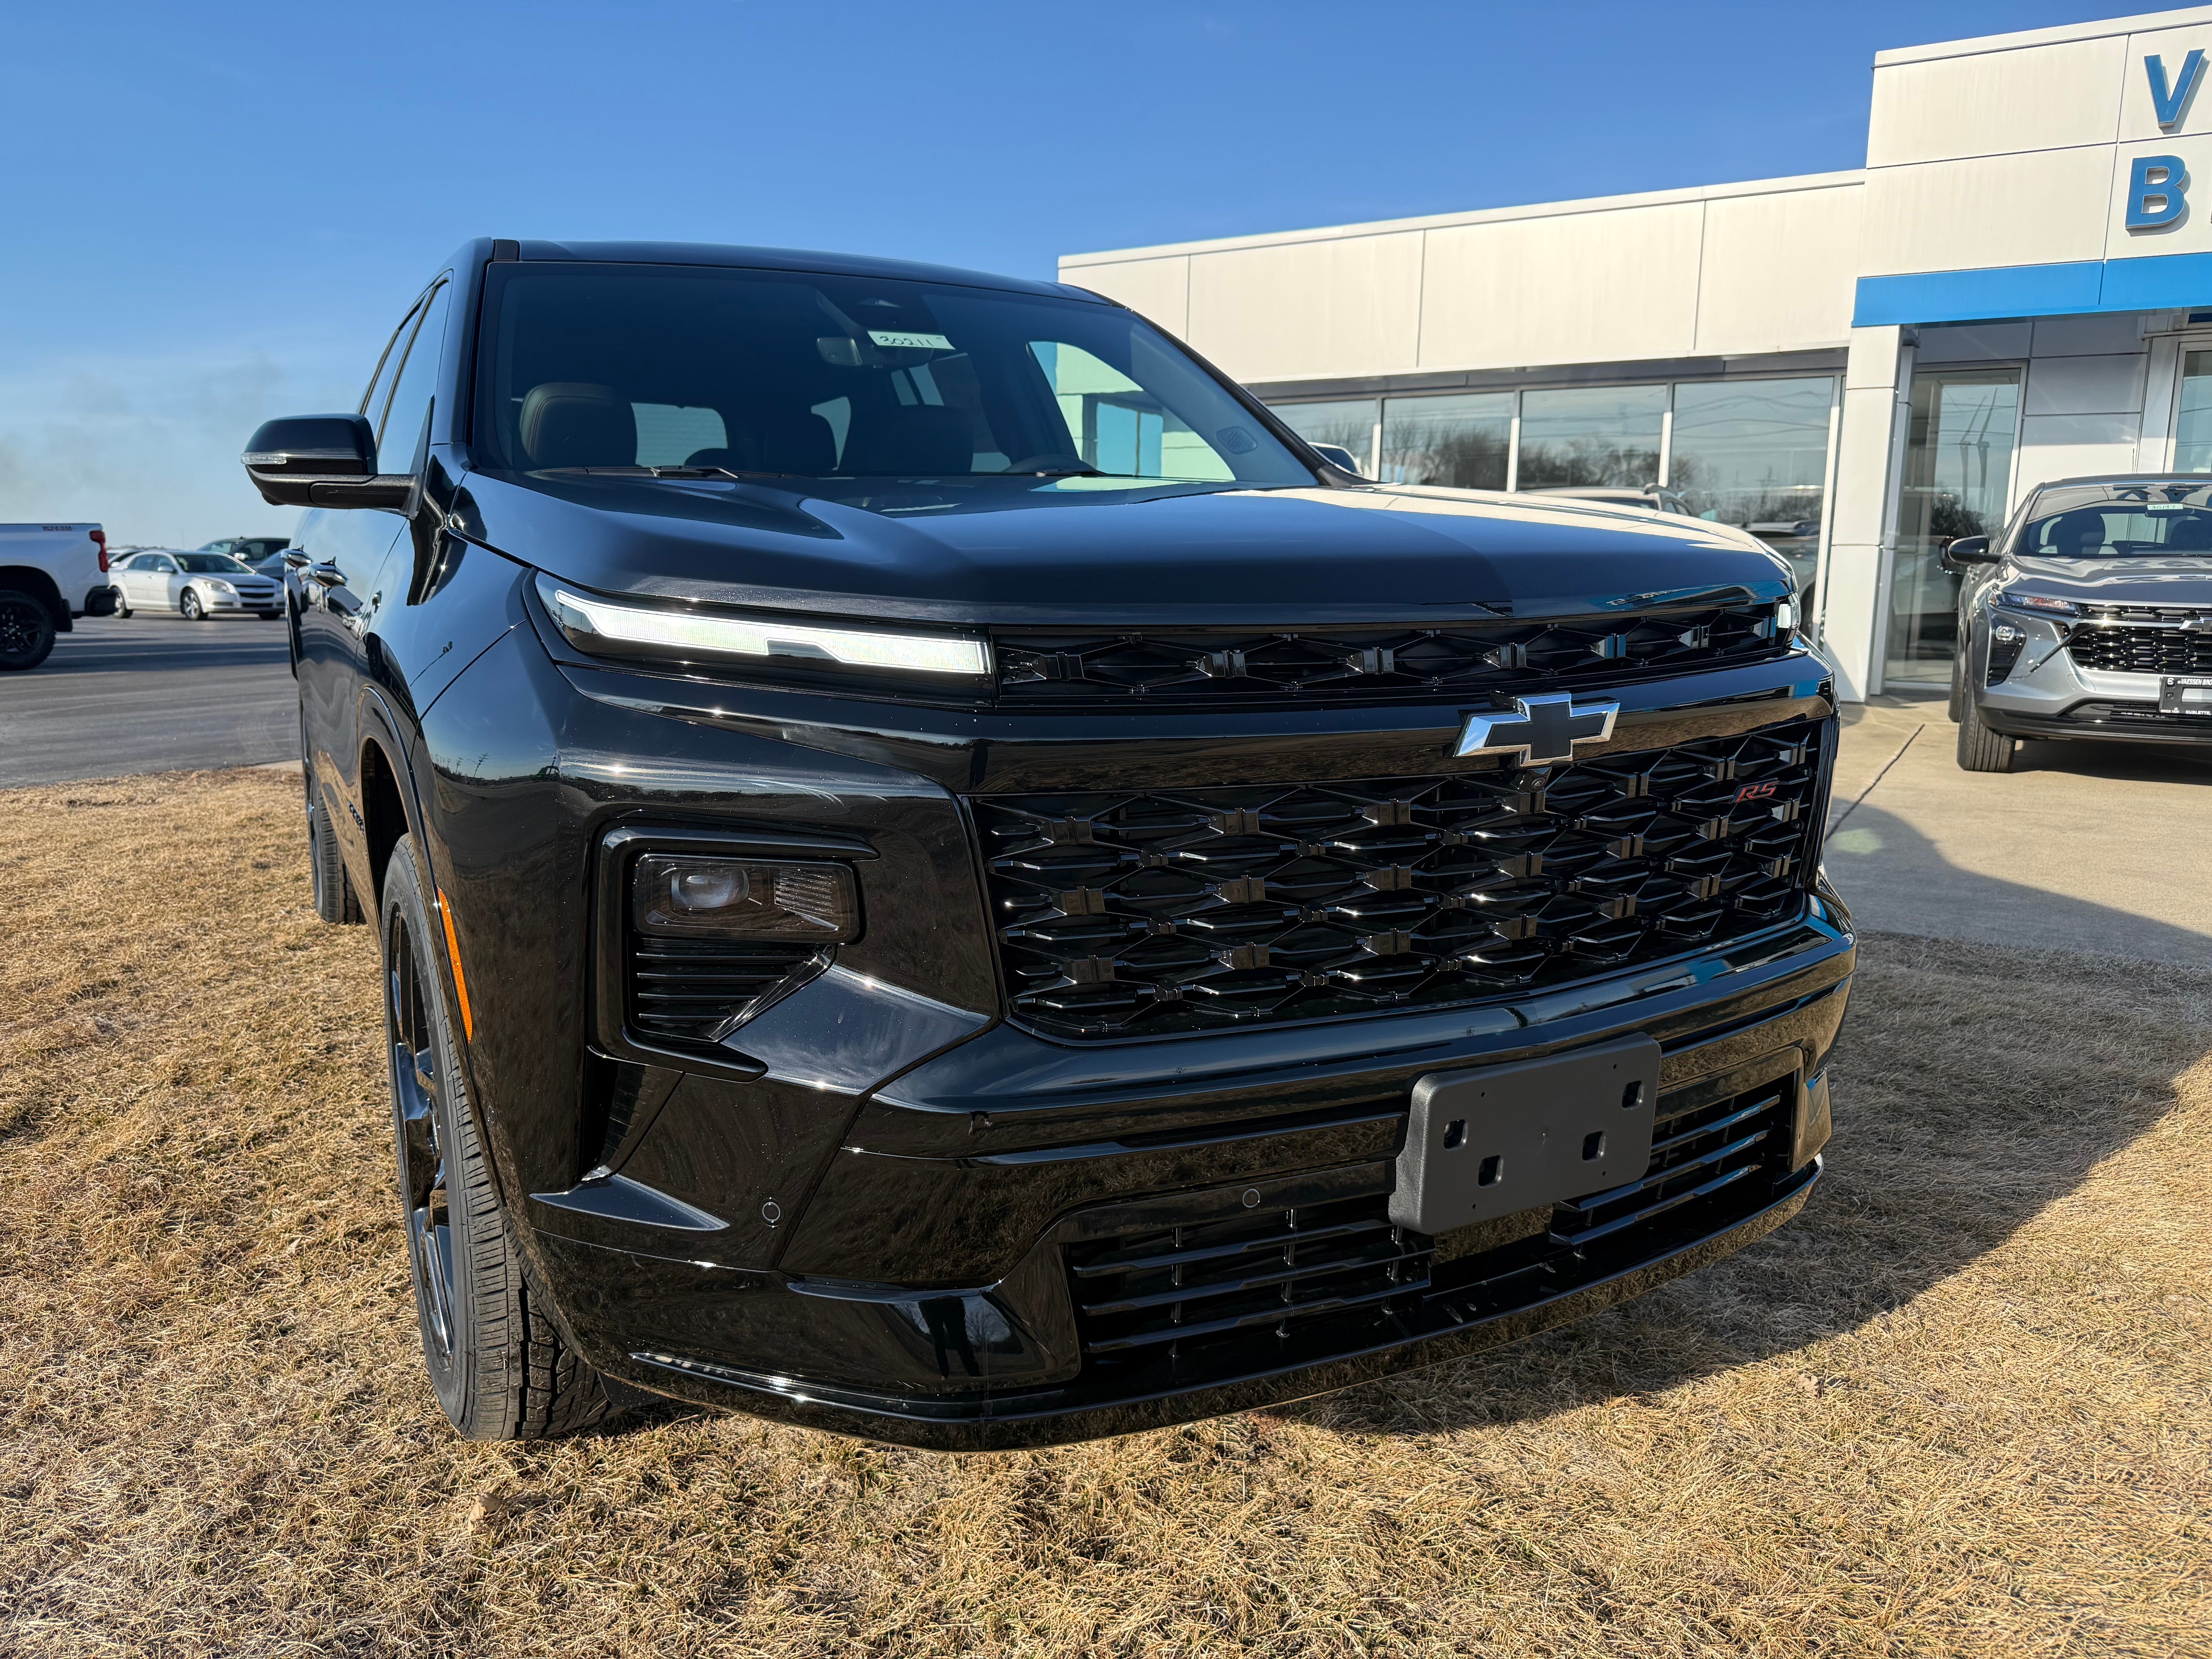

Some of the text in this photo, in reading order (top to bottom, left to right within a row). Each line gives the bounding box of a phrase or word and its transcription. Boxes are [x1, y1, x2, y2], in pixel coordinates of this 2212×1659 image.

[2125, 155, 2212, 230] B
[879, 336, 934, 347] 30211
[1736, 781, 1779, 803] RS
